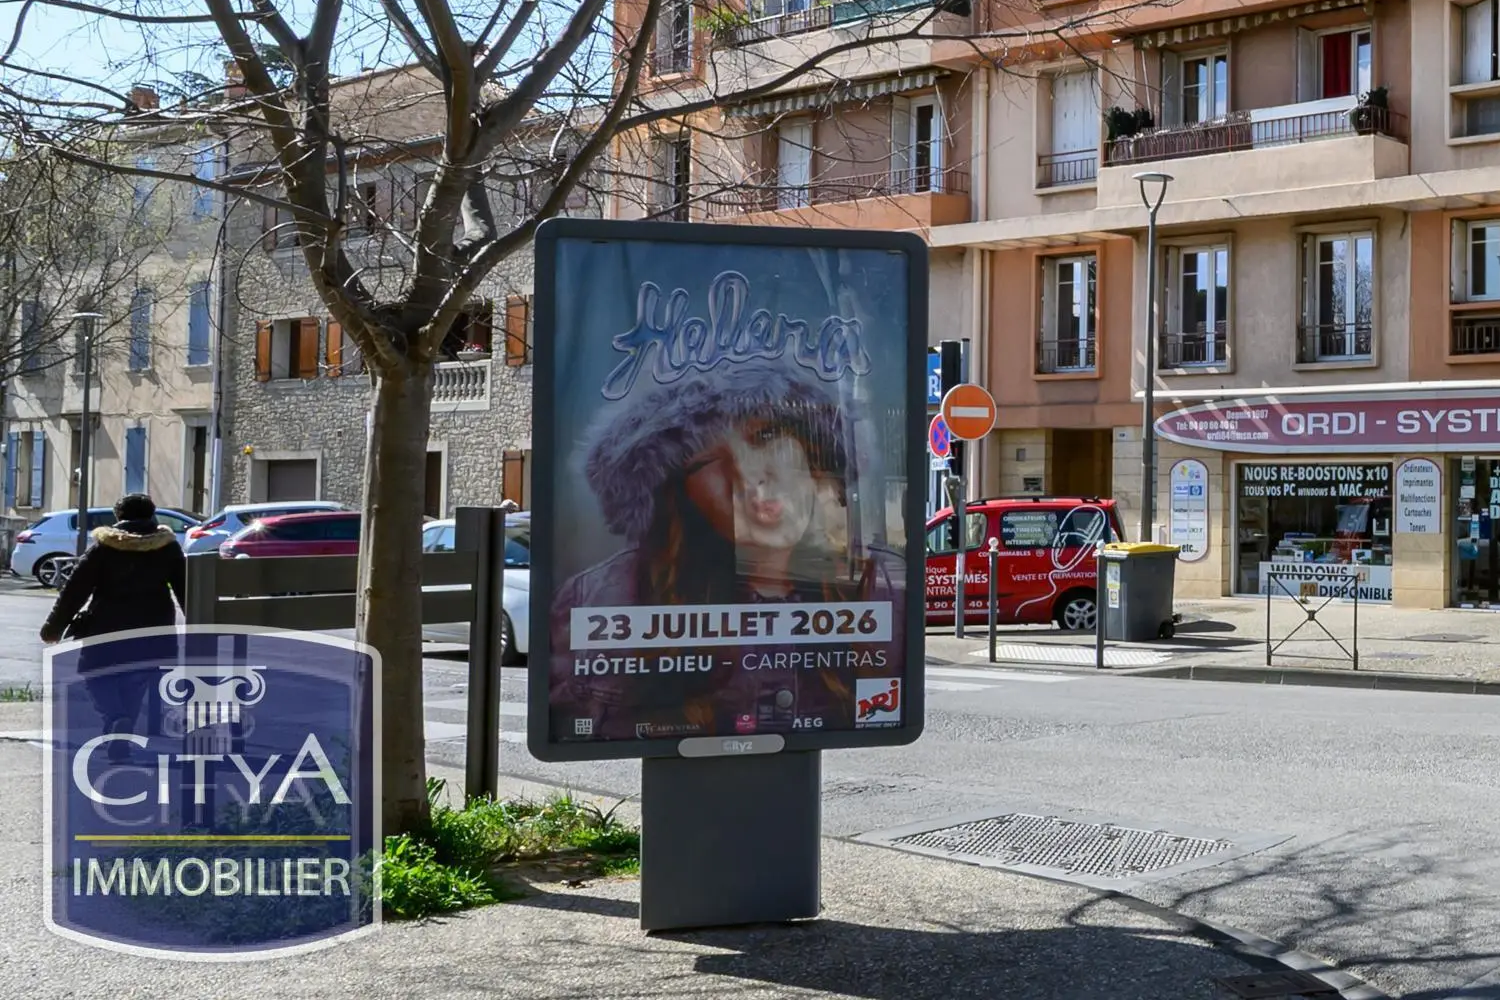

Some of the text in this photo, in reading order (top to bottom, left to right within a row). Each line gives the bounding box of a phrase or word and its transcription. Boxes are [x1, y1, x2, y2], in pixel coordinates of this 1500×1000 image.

[1281, 411, 1366, 436] ORDI
[1244, 466, 1389, 481] NOUS RE-BOOSTONS x10
[1244, 486, 1264, 497] TOUS
[1265, 486, 1281, 496] VOS
[1283, 483, 1296, 496] PC
[1298, 487, 1329, 497] WINDOWS
[1330, 486, 1337, 497] &
[1338, 483, 1363, 497] MAC
[1012, 574, 1037, 582] VENTE
[1271, 563, 1348, 583] WINDOWS
[1320, 585, 1393, 600] DISPONIBLE
[586, 608, 878, 641] 23 JUILLET 2026
[573, 653, 651, 676] HÔTEL
[658, 655, 713, 673] DIEU
[741, 650, 888, 671] CARPENTRAS
